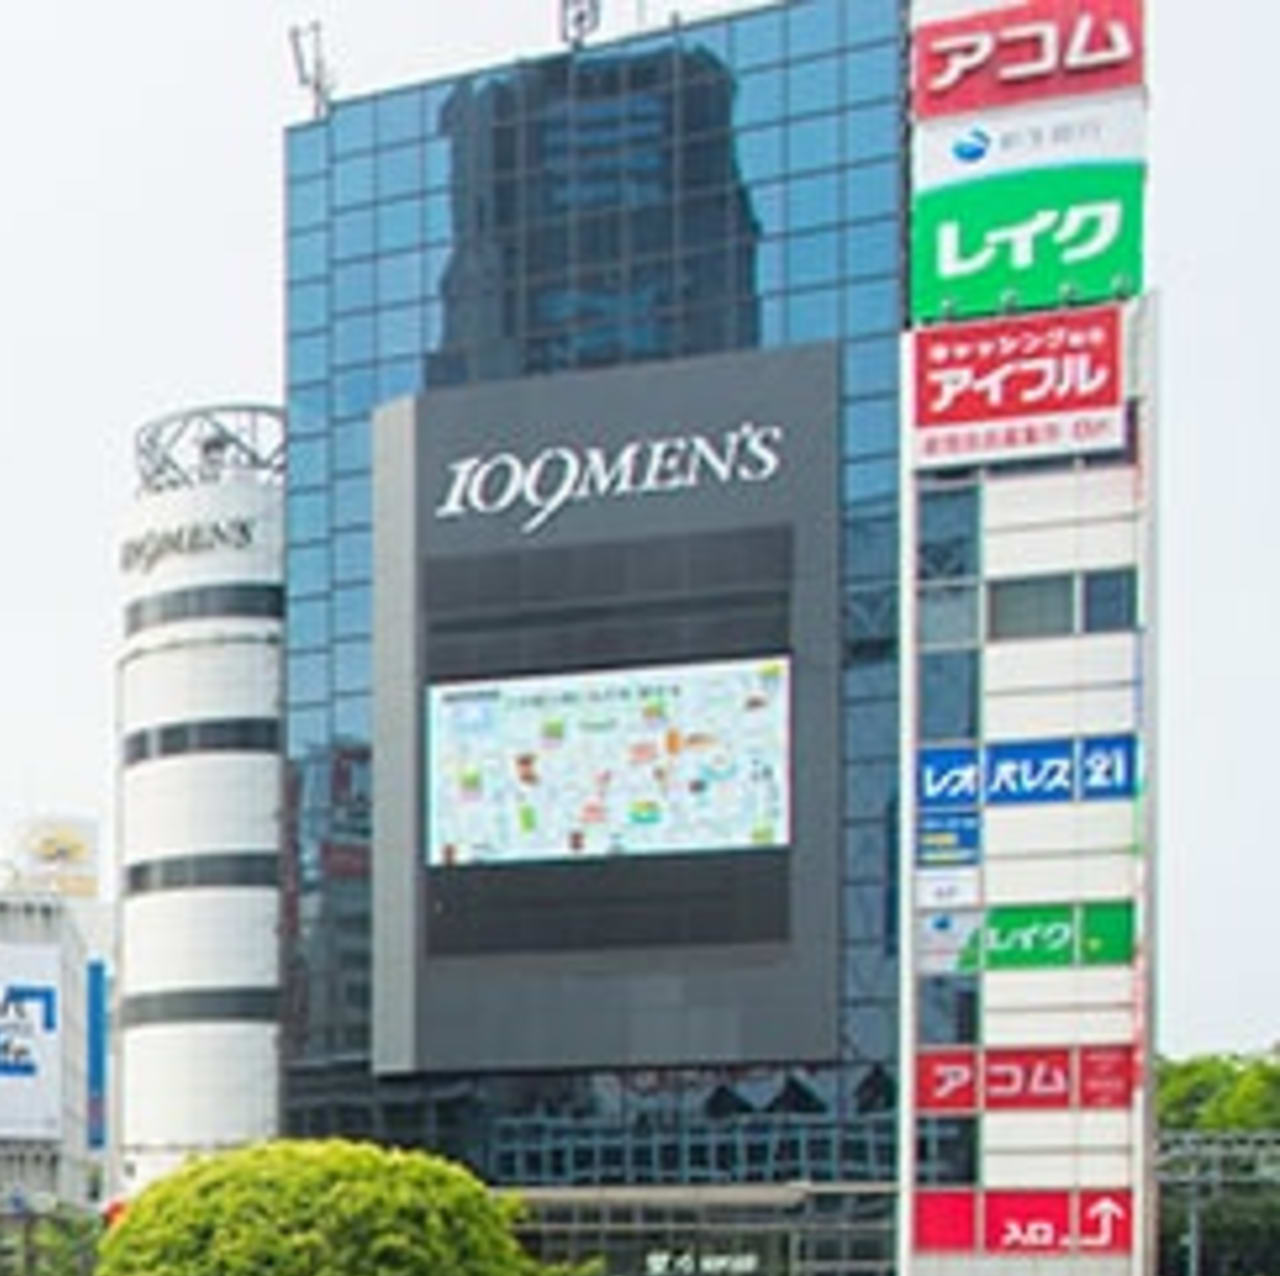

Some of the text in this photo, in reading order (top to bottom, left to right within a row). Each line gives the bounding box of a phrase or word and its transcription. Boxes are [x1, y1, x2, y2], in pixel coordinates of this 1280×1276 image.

[928, 13, 1132, 90] アコム
[937, 201, 1122, 277] レイク
[927, 353, 1109, 413] アイフル
[435, 421, 782, 532] 109MEN'S
[987, 921, 1074, 951] レイク
[934, 1062, 1065, 1097] アコム
